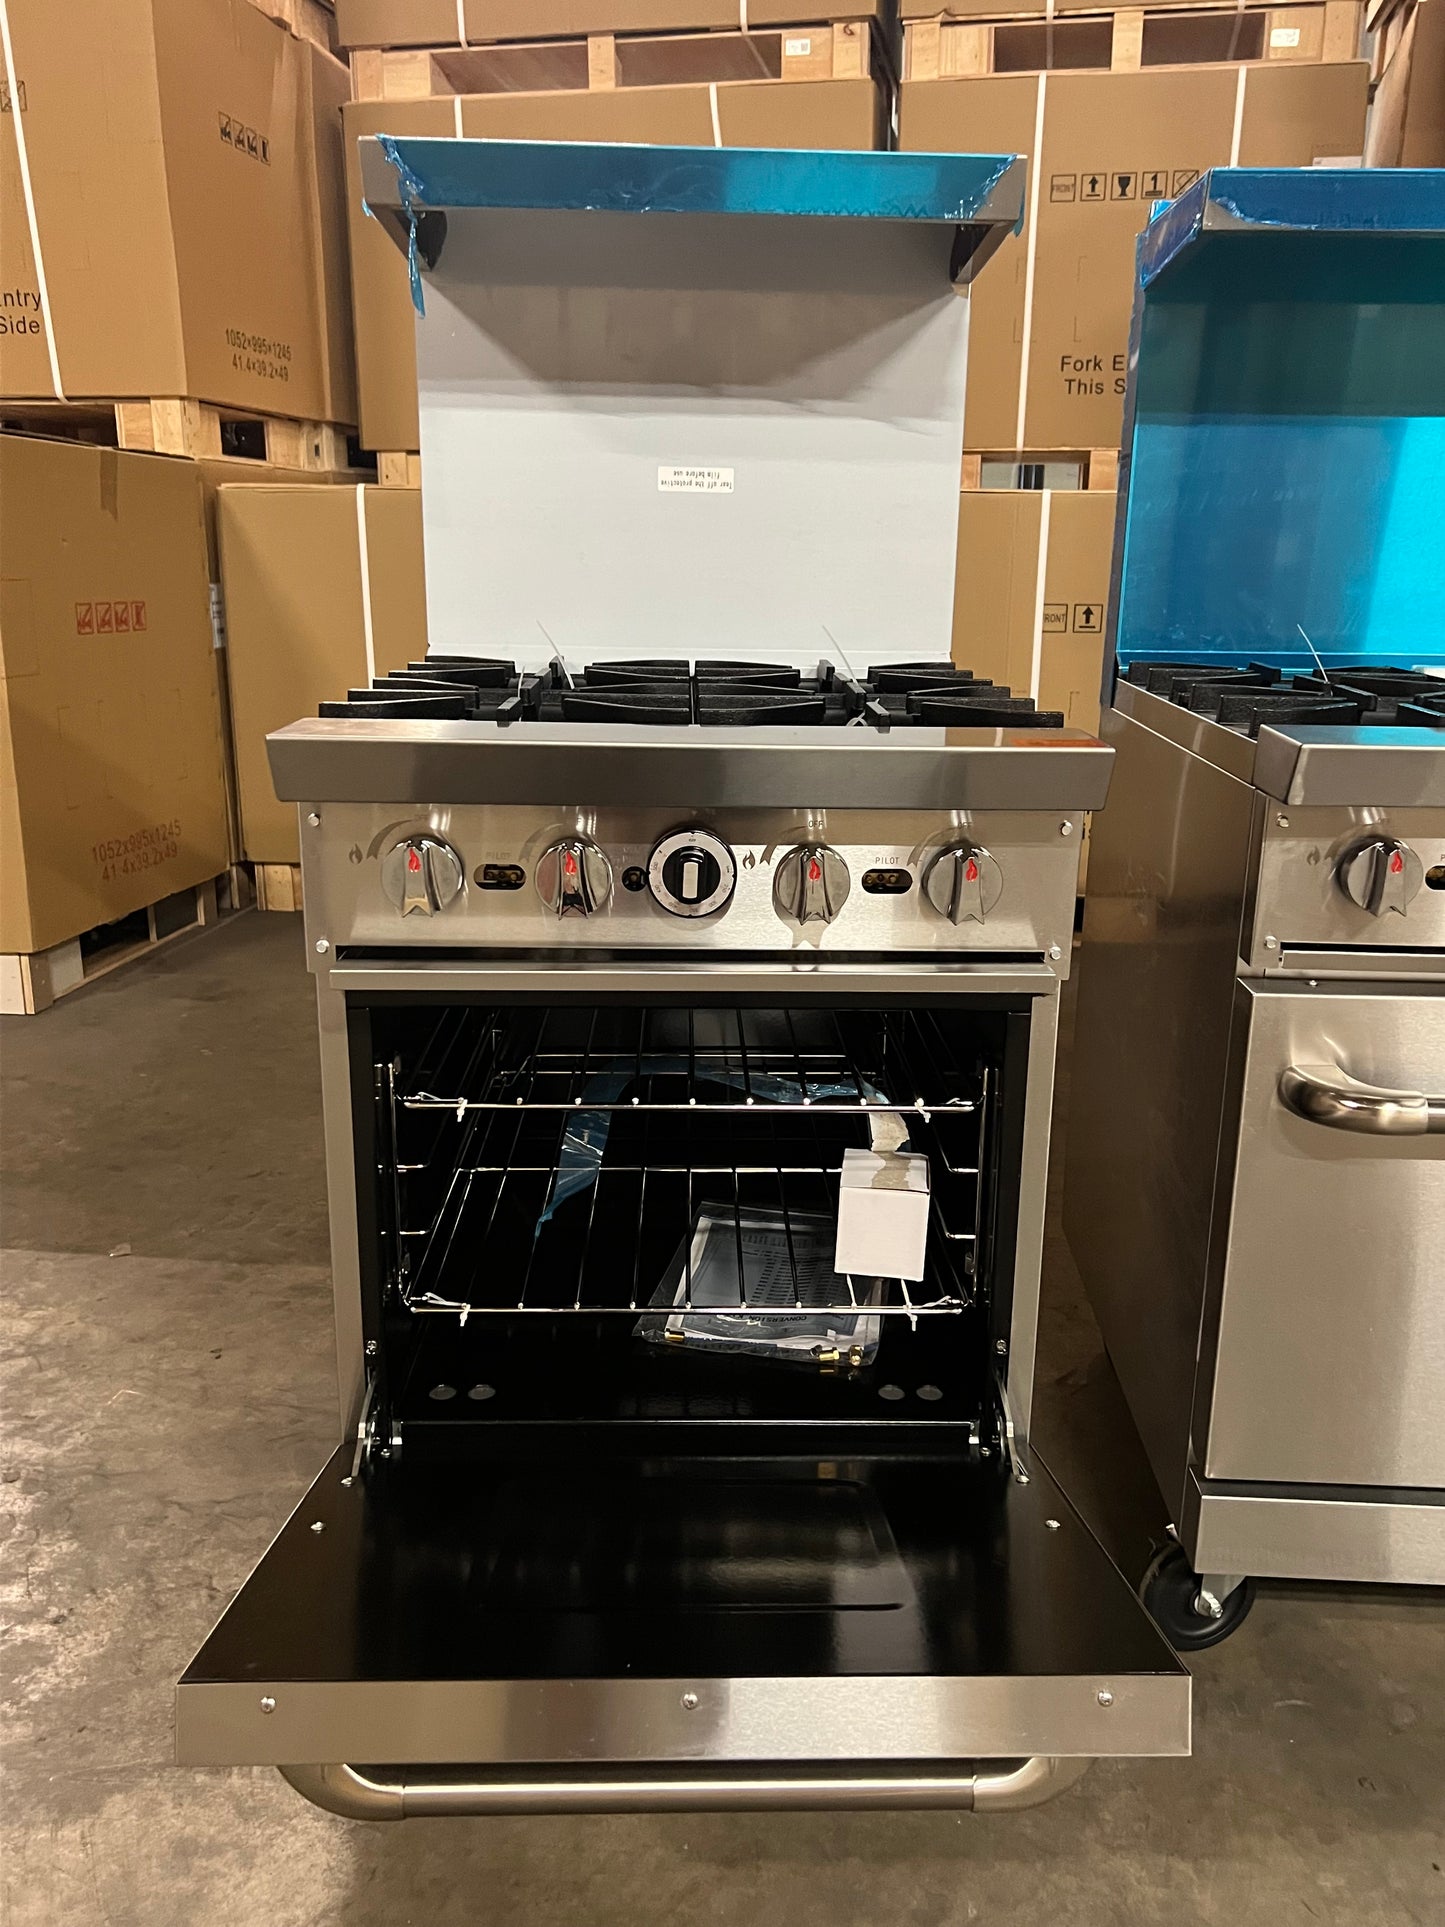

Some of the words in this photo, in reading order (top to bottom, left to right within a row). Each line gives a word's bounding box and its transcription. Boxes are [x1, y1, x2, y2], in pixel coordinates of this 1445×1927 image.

[0, 288, 41, 311] ntry
[0, 315, 40, 334] Side
[1060, 354, 1103, 372] Fork
[1112, 354, 1125, 371] E
[1064, 378, 1104, 395] This
[1113, 378, 1126, 395] S
[1043, 613, 1066, 623] RONT
